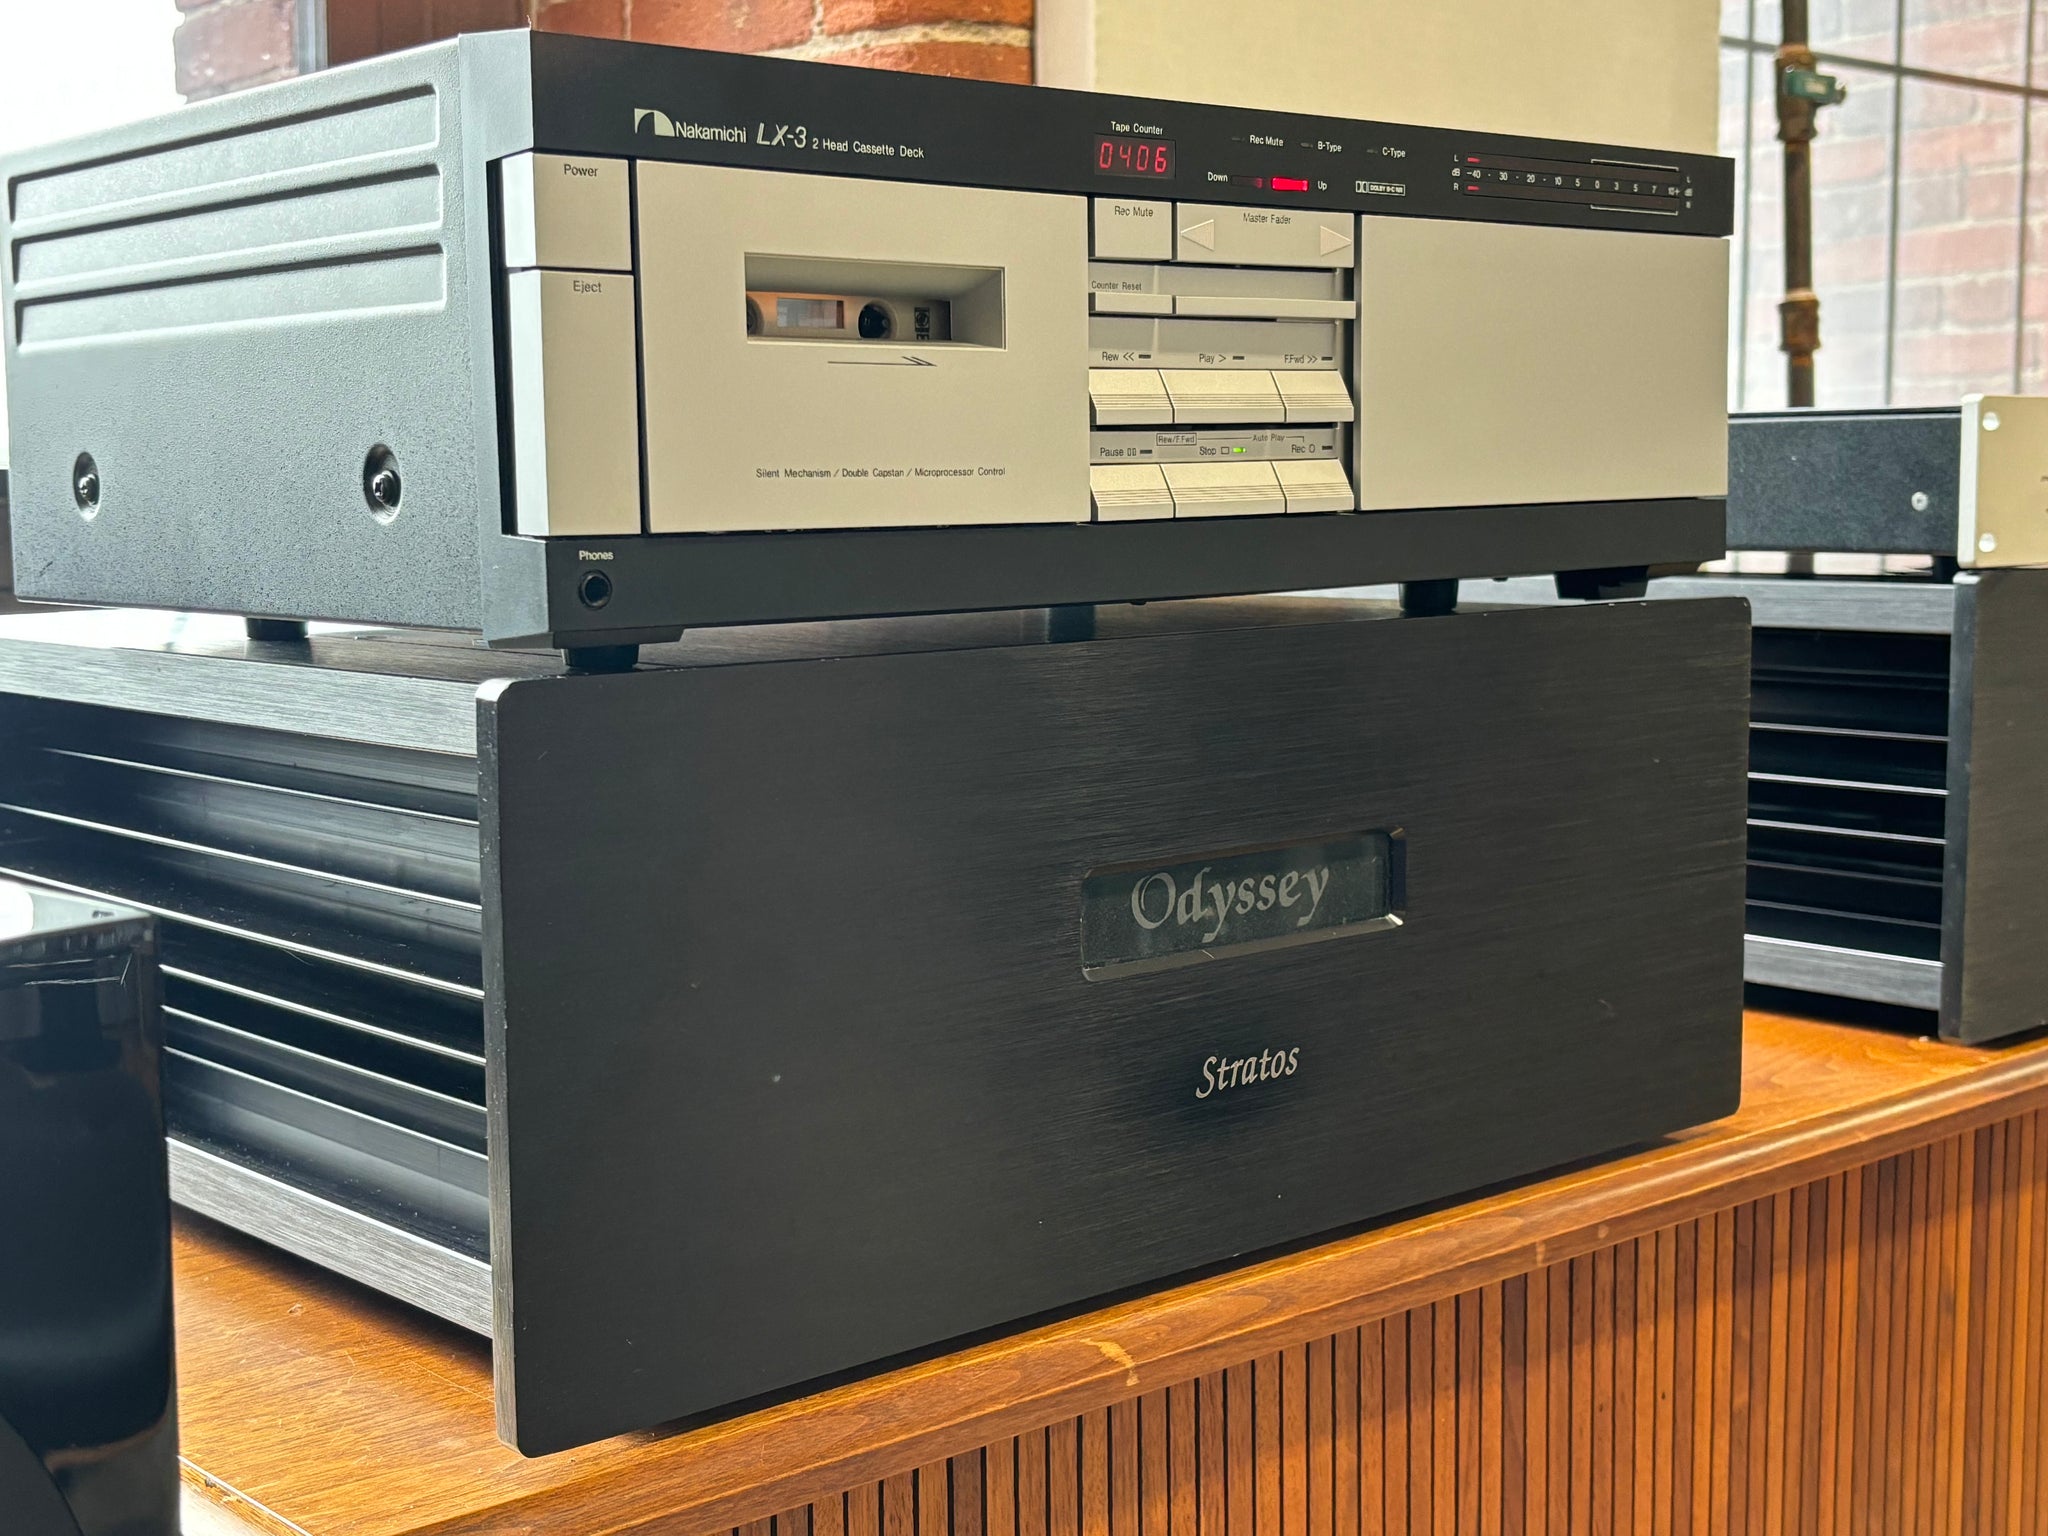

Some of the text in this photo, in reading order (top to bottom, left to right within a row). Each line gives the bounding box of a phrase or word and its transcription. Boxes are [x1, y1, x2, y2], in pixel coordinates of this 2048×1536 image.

[1110, 121, 1163, 135] Tape Counter
[675, 120, 807, 149] Nakamichi LX-3
[1249, 134, 1284, 147] Rec Mute
[812, 138, 925, 158] 2 Head Cassette Deck
[1317, 141, 1342, 152] B-Type
[1382, 146, 1406, 158] C-Type
[1100, 142, 1167, 173] 0406
[1453, 154, 1459, 162] L
[563, 163, 599, 177] Power
[1207, 171, 1228, 182] Down
[1499, 171, 1508, 181] 30
[1526, 174, 1536, 183] 20
[1554, 176, 1562, 186] 10
[1575, 178, 1581, 187] 5
[1614, 181, 1620, 191] 3
[1633, 183, 1638, 192] 5
[1317, 181, 1328, 191] Up
[1114, 205, 1154, 217] Rec Mute
[1243, 212, 1291, 225] Master Fader
[573, 280, 602, 294] Eject
[1091, 280, 1142, 291] Counter Reset
[1102, 351, 1119, 361] Rew
[1198, 353, 1215, 364] Play
[1253, 433, 1285, 442] Auto Play
[1100, 447, 1124, 456] Pause
[1199, 446, 1217, 456] Stop
[1291, 444, 1306, 453] Rec
[756, 467, 780, 478] Silent
[784, 468, 832, 478] Mechanism
[842, 468, 869, 478] Double
[872, 467, 904, 479] Capstan
[914, 467, 975, 478] Microprocessor
[977, 466, 1006, 476] Control
[578, 550, 614, 561] Phones
[1131, 866, 1329, 943] Odyssey
[1195, 1047, 1300, 1099] Stratos
